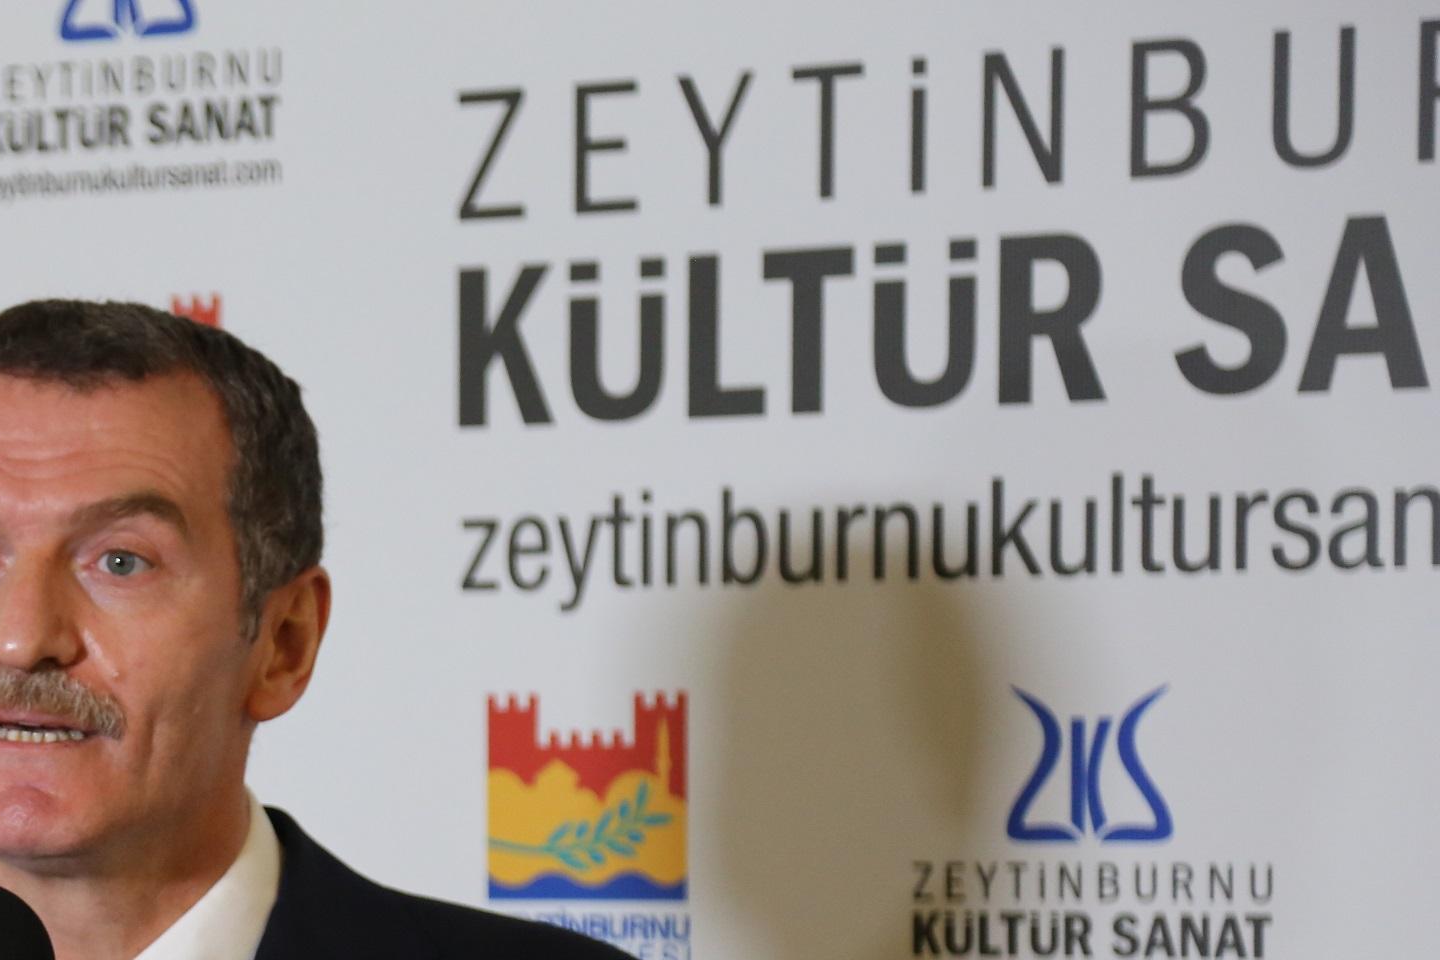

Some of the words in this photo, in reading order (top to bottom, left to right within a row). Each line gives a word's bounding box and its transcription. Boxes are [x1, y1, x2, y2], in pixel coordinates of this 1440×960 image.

[147, 97, 279, 147] SANAT
[457, 233, 1108, 430] KÜLTÜR
[1173, 213, 1431, 397] SA
[460, 472, 1440, 614] zeytinburnukultursan
[912, 912, 1093, 960] KÜLTÜR
